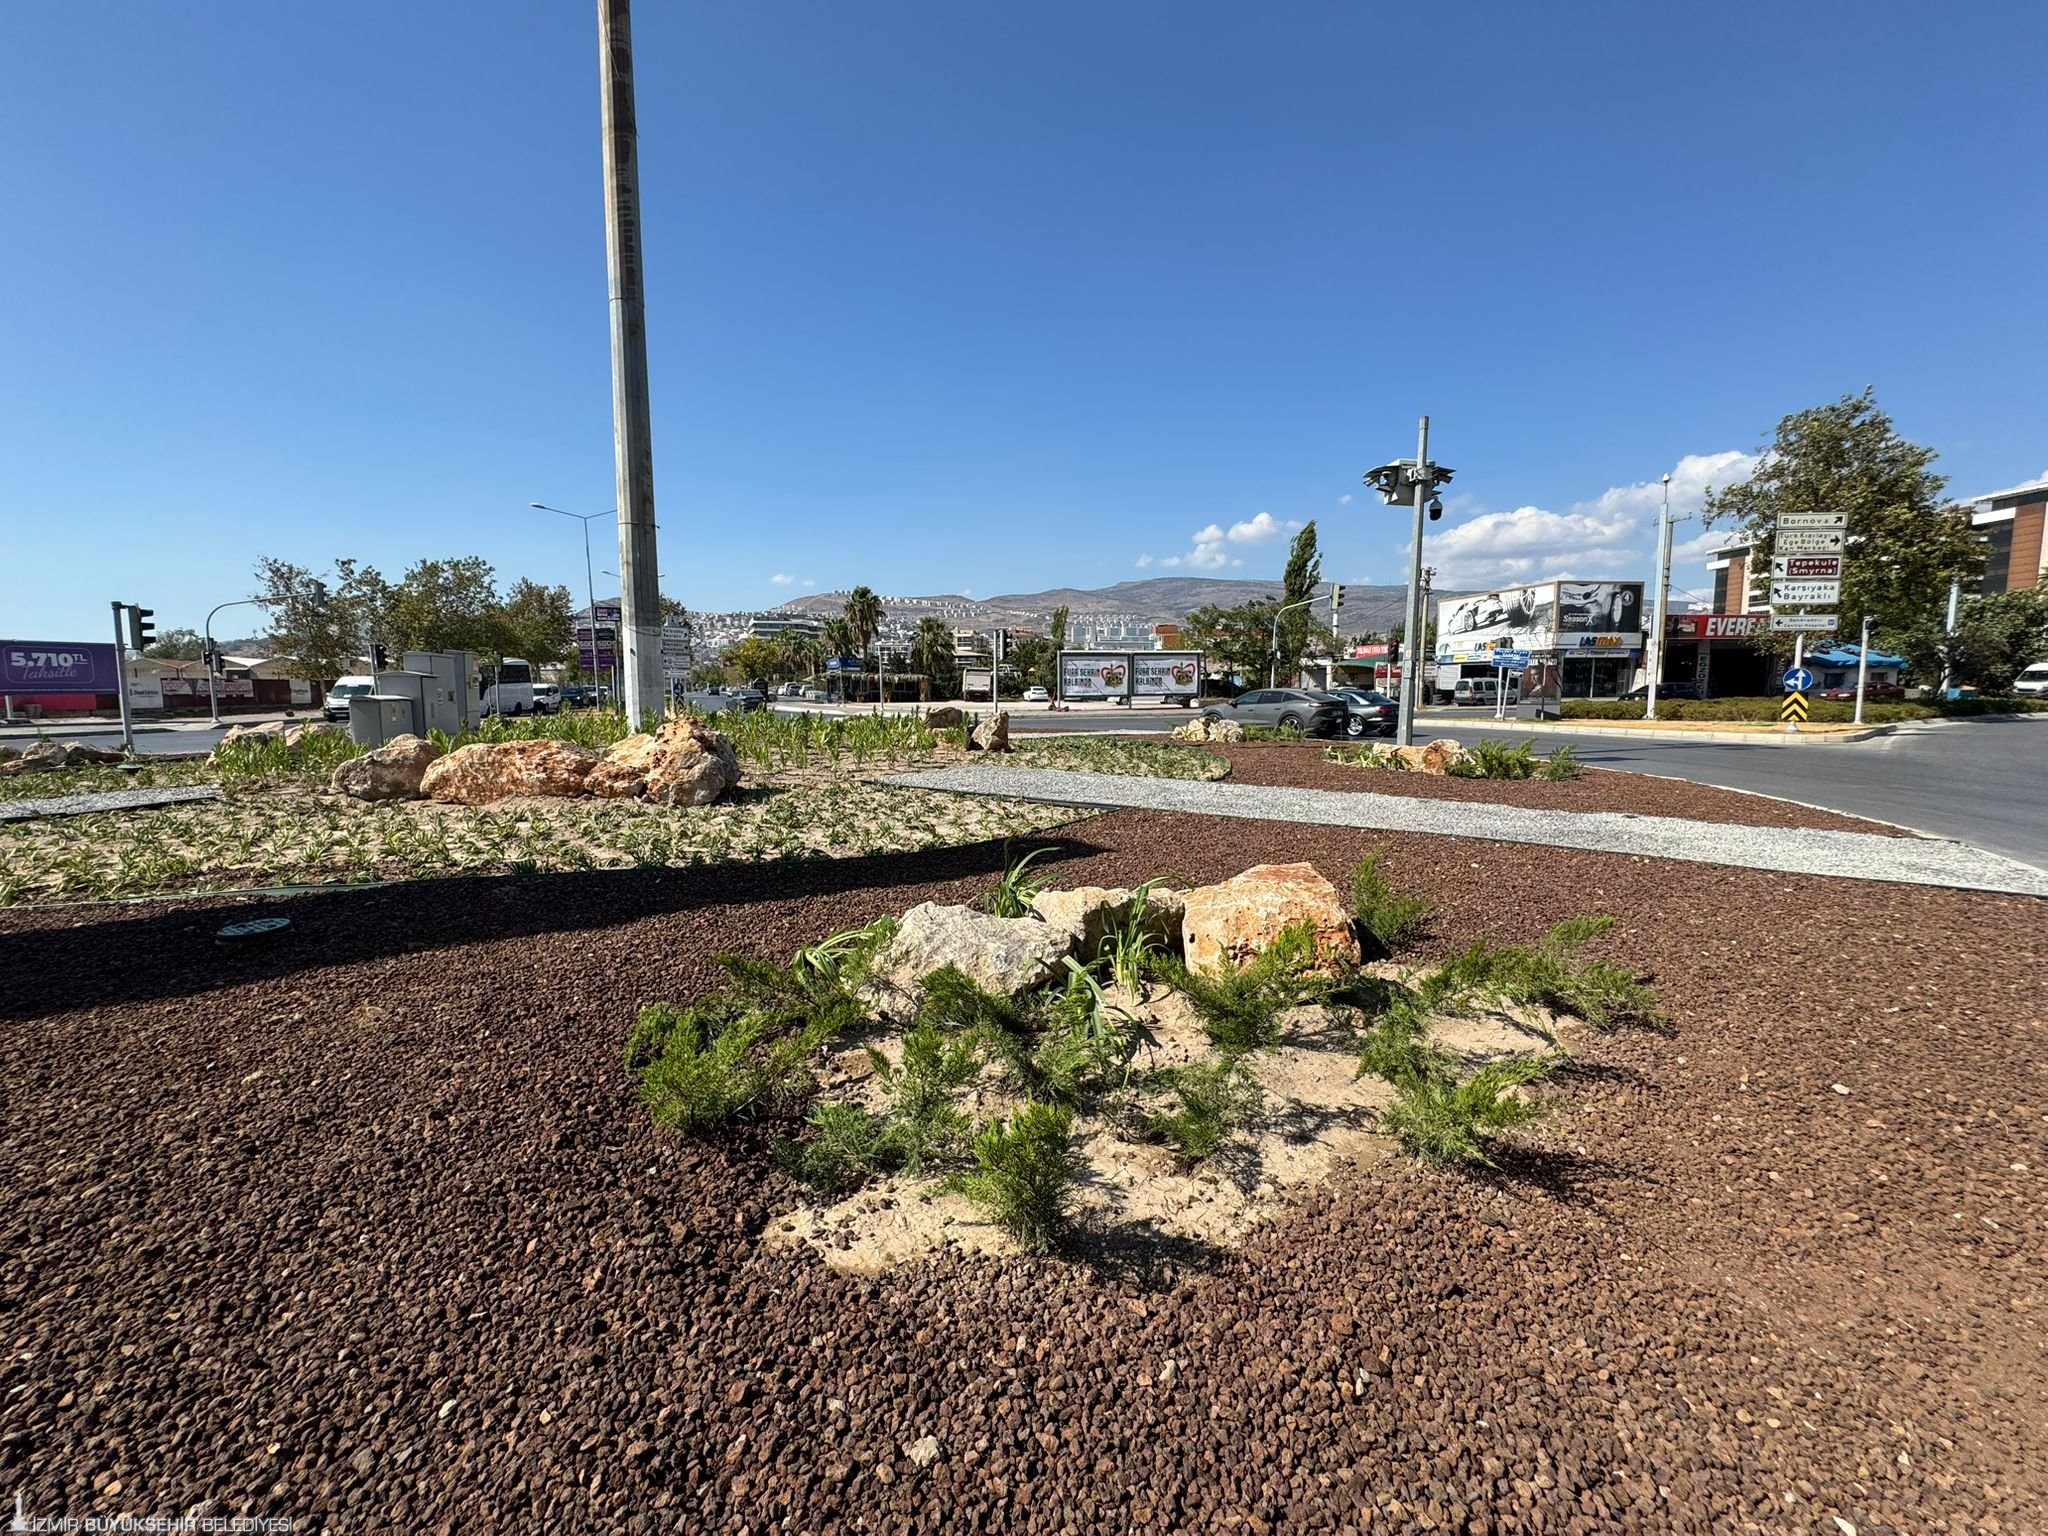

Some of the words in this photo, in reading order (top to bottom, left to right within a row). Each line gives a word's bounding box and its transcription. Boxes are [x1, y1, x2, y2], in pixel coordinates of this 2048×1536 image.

[1783, 517, 1829, 525] Bornova
[1789, 559, 1838, 567] Tepekule
[1788, 567, 1837, 576] (Smyrna)
[1784, 584, 1835, 593] Karşıyaka
[1783, 593, 1831, 601] Bayraklı
[1705, 617, 1763, 636] EVERE
